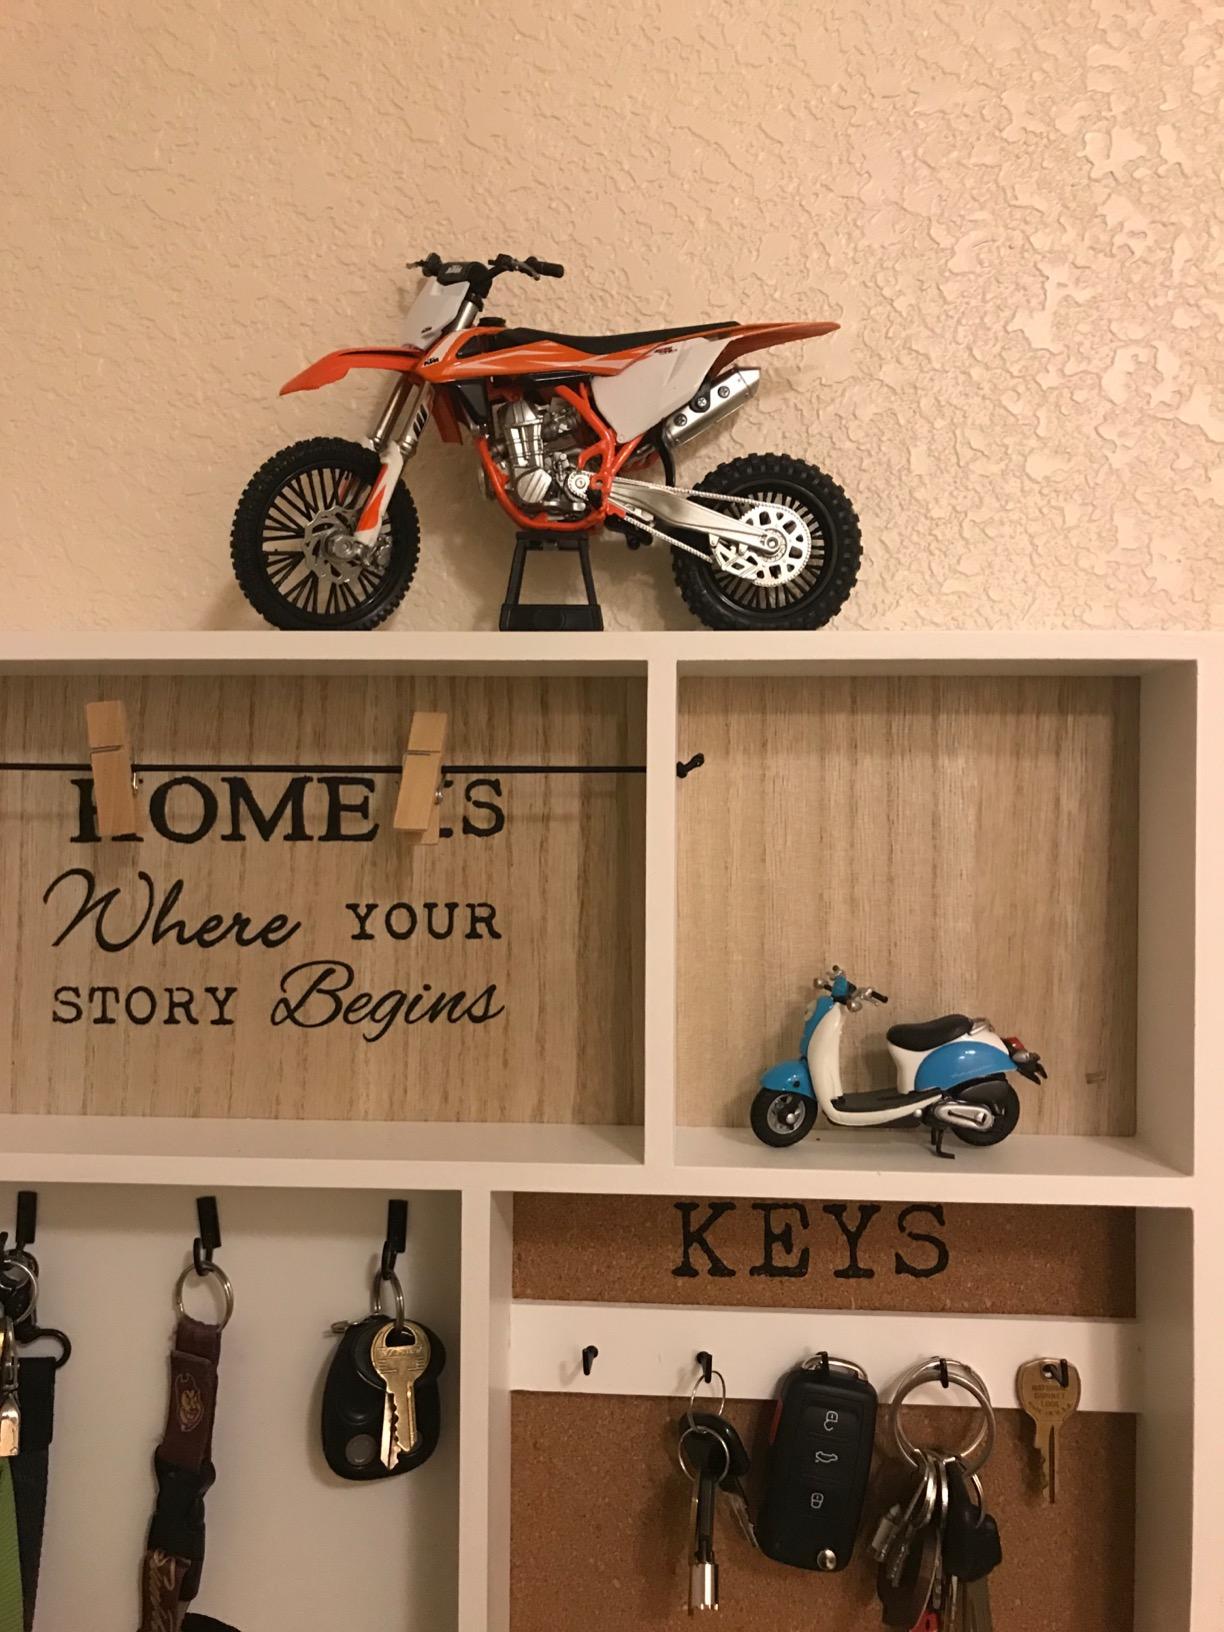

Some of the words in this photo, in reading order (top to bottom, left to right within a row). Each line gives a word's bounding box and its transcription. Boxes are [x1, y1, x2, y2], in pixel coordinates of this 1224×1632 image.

[436, 778, 506, 838] S
[43, 868, 301, 952] Where
[345, 902, 502, 940] YOUR
[53, 986, 237, 1025] STORY
[271, 960, 505, 1042] Begins
[671, 1202, 949, 1279] KEYS
